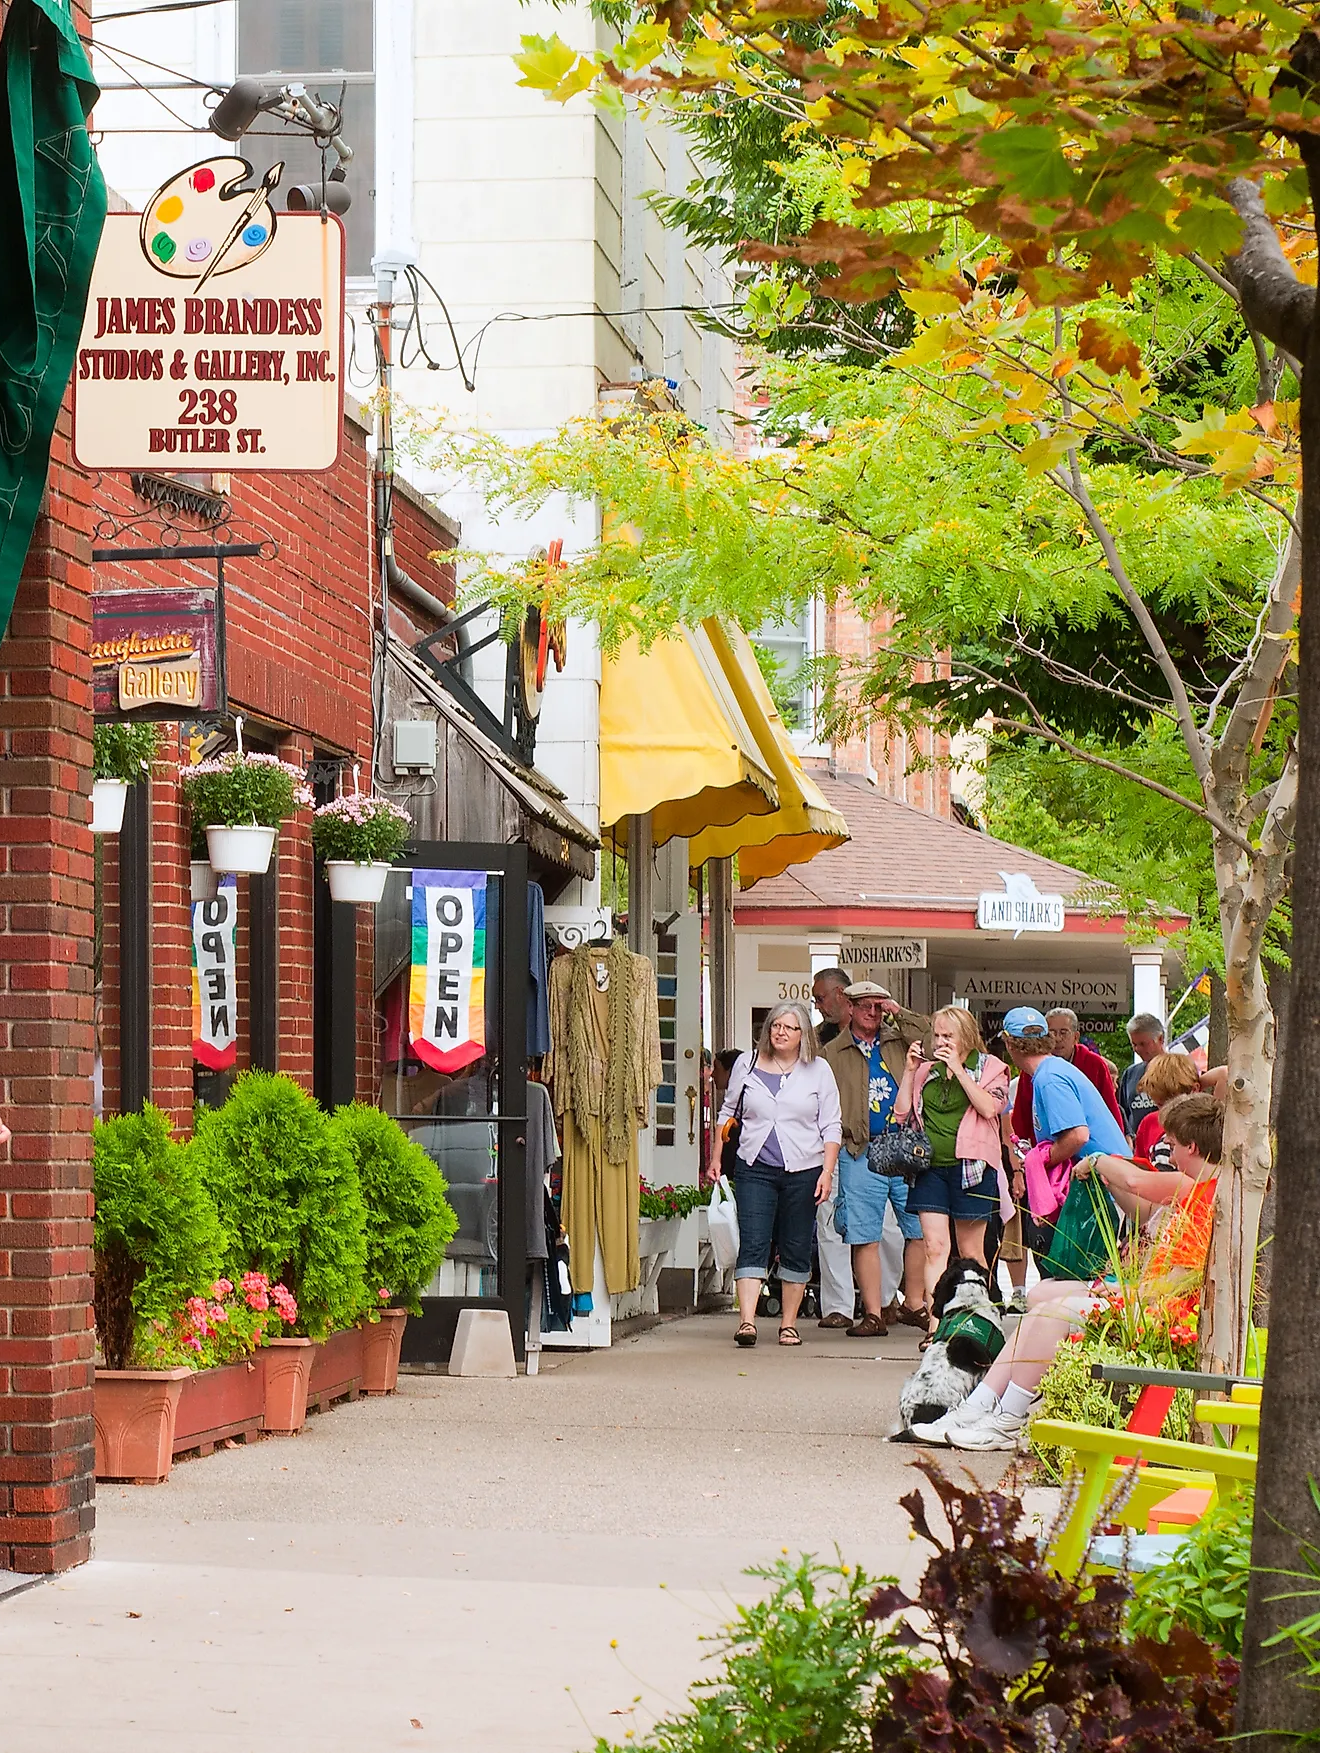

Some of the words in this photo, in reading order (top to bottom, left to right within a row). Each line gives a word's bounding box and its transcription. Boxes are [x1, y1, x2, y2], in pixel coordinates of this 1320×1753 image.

[94, 298, 176, 339] JAMES
[184, 298, 322, 335] BRANDESS
[79, 349, 164, 381] STUDIOS
[169, 349, 188, 381] &
[194, 350, 290, 386] GALLERY,
[296, 350, 335, 382] INC.
[178, 389, 237, 425] 238
[148, 428, 230, 454] BUTLER
[236, 429, 266, 453] ST.
[89, 631, 193, 663] aughman
[122, 666, 198, 702] Gallery
[983, 900, 1012, 924] LAND
[1015, 901, 1060, 927] SHARK'S
[435, 894, 464, 1039] OPEN
[838, 945, 914, 965] ANDSHARK'S
[778, 982, 810, 1000] 306
[964, 977, 1056, 995] AMERICAN
[1061, 978, 1117, 996] SPOON
[1080, 1021, 1114, 1032] ROOM
